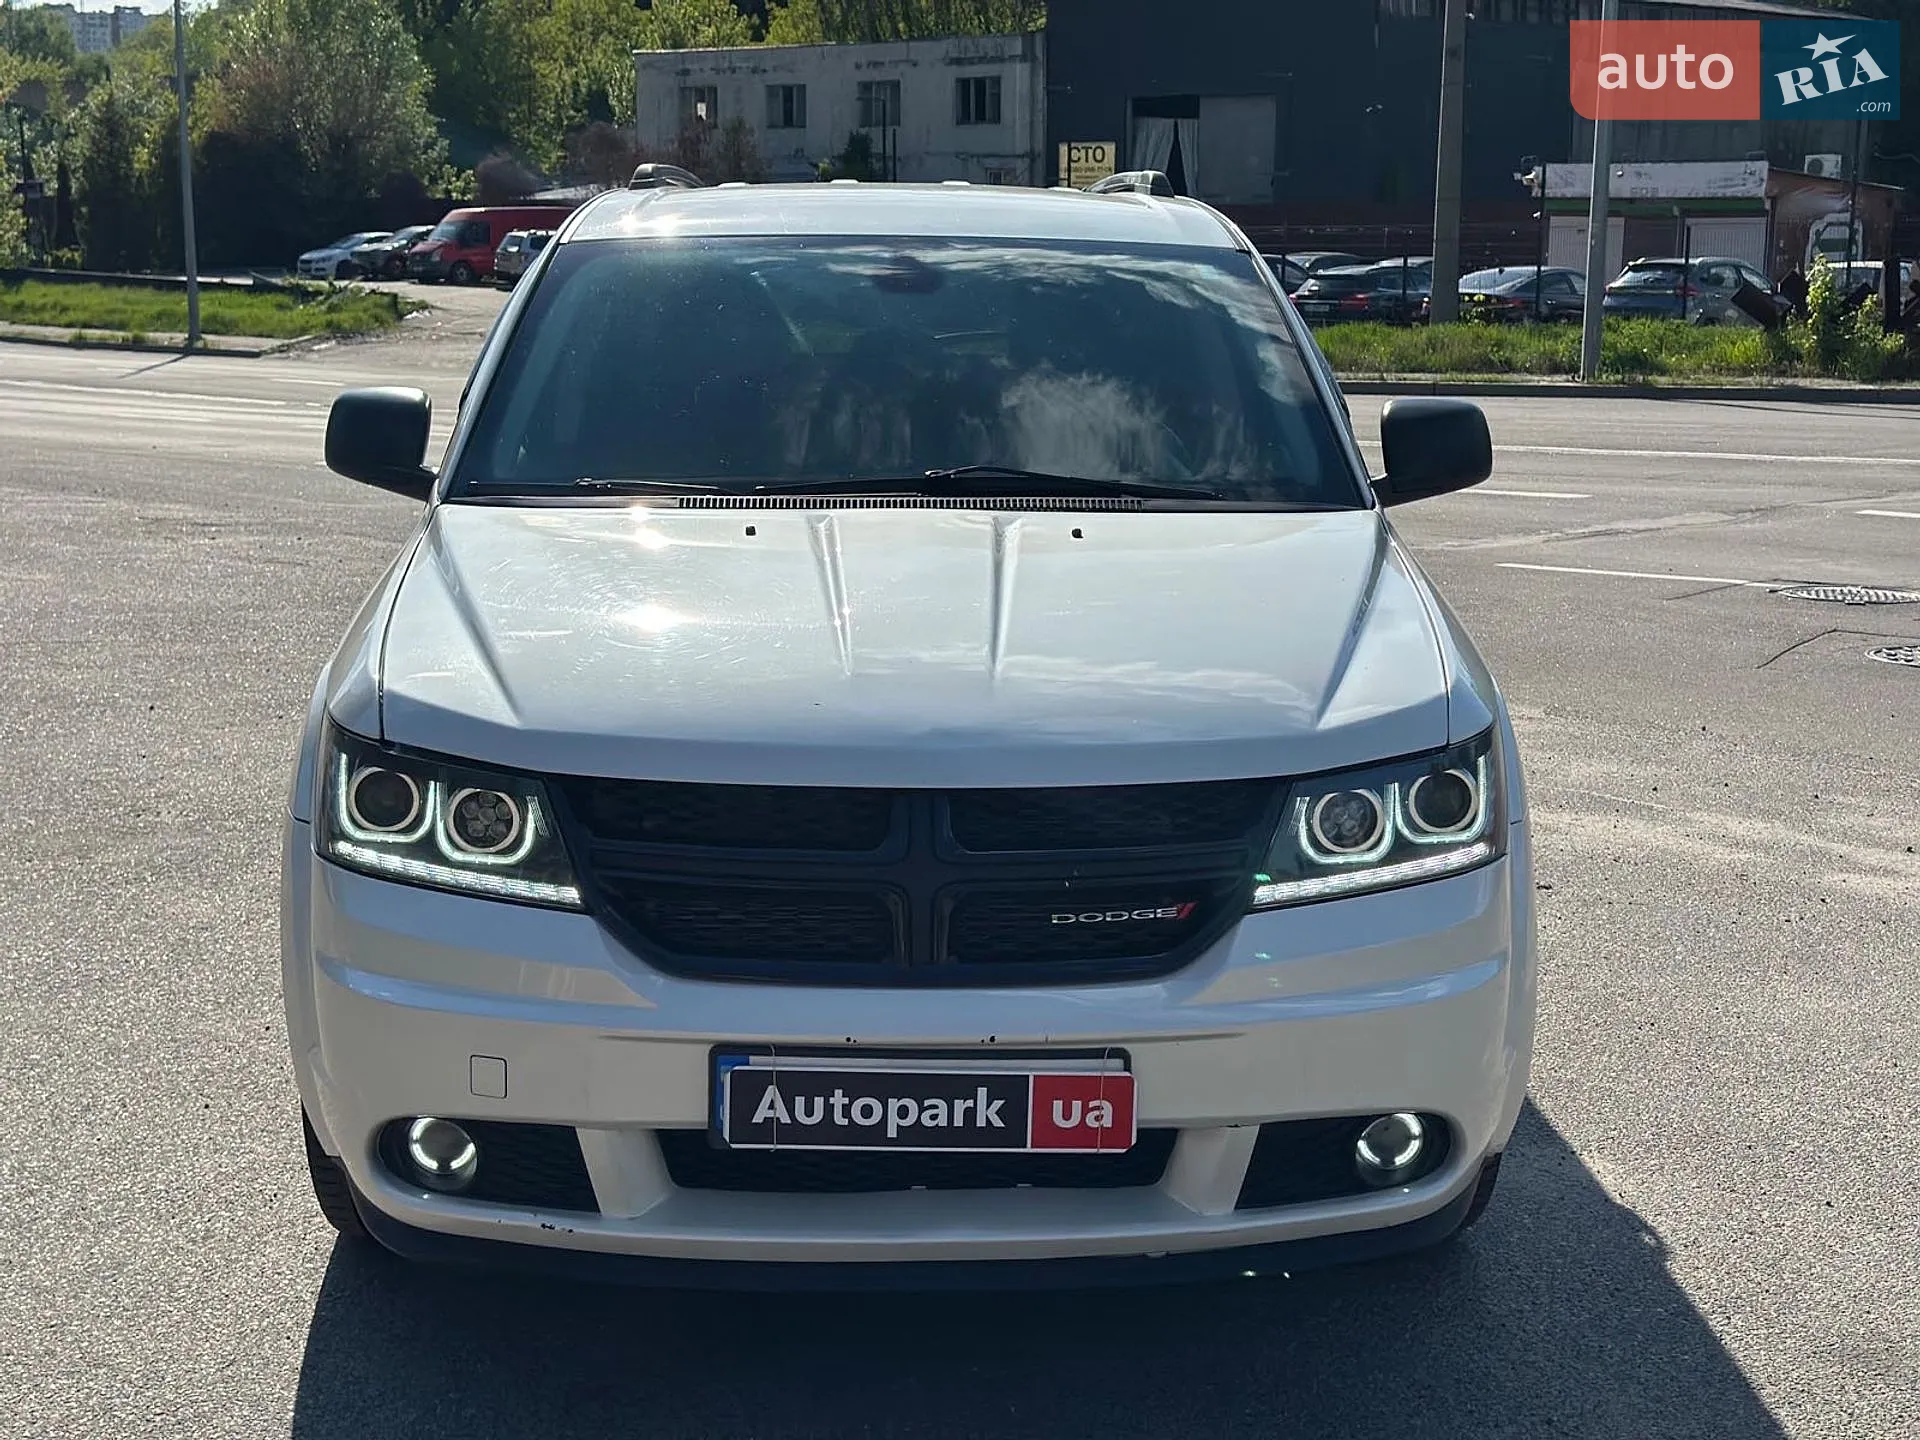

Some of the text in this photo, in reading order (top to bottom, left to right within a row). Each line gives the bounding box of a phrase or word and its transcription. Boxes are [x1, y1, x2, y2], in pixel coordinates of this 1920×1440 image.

[1070, 146, 1105, 163] СТО
[1051, 907, 1178, 924] DODGE
[751, 1085, 1114, 1138] Autopark ua
